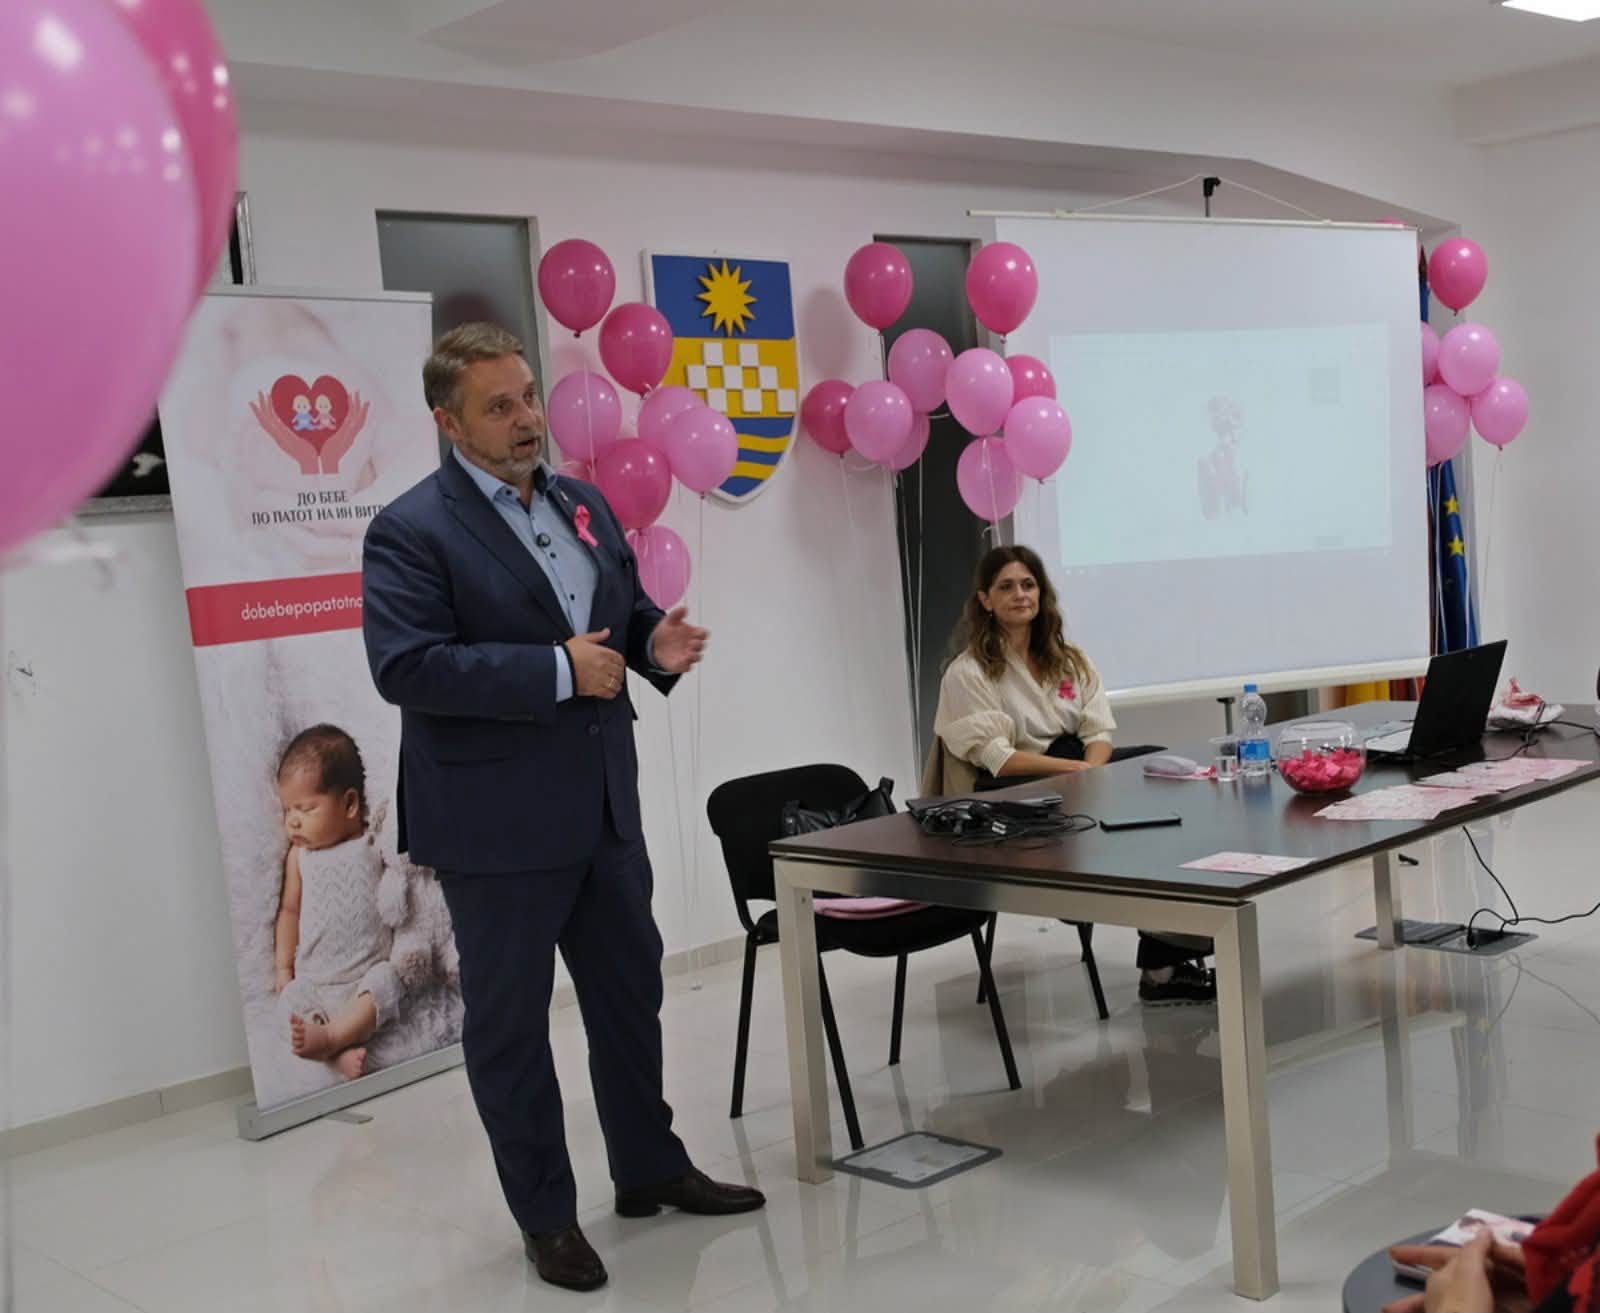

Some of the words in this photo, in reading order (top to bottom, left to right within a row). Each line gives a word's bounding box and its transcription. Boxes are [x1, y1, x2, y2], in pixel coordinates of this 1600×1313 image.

[297, 491, 316, 506] ДО
[319, 489, 347, 504] БЕБЕ
[252, 511, 271, 525] ПО
[273, 509, 313, 523] ПАТОТ
[316, 508, 334, 520] НА
[335, 506, 353, 519] ИН
